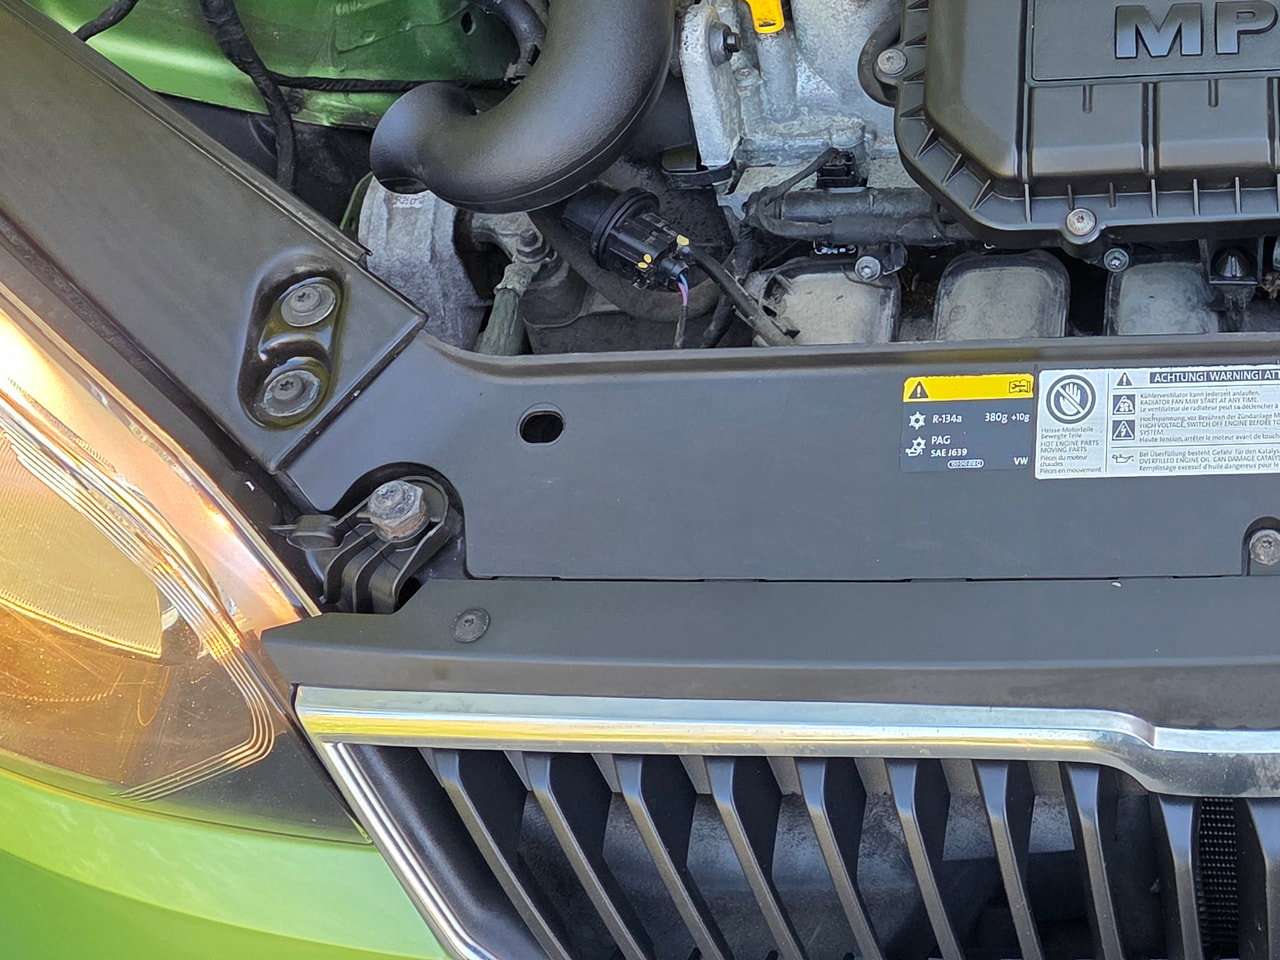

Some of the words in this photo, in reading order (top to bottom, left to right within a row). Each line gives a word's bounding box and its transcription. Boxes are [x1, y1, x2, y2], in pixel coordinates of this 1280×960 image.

[1154, 372, 1207, 383] ACHTUNG!
[1209, 370, 1262, 381] WARNING!
[932, 414, 962, 424] R-134a
[984, 412, 1008, 424] 380g
[931, 435, 951, 445] PAG
[931, 448, 946, 457] SAE
[947, 448, 968, 457] J639
[1013, 456, 1029, 465] VW
